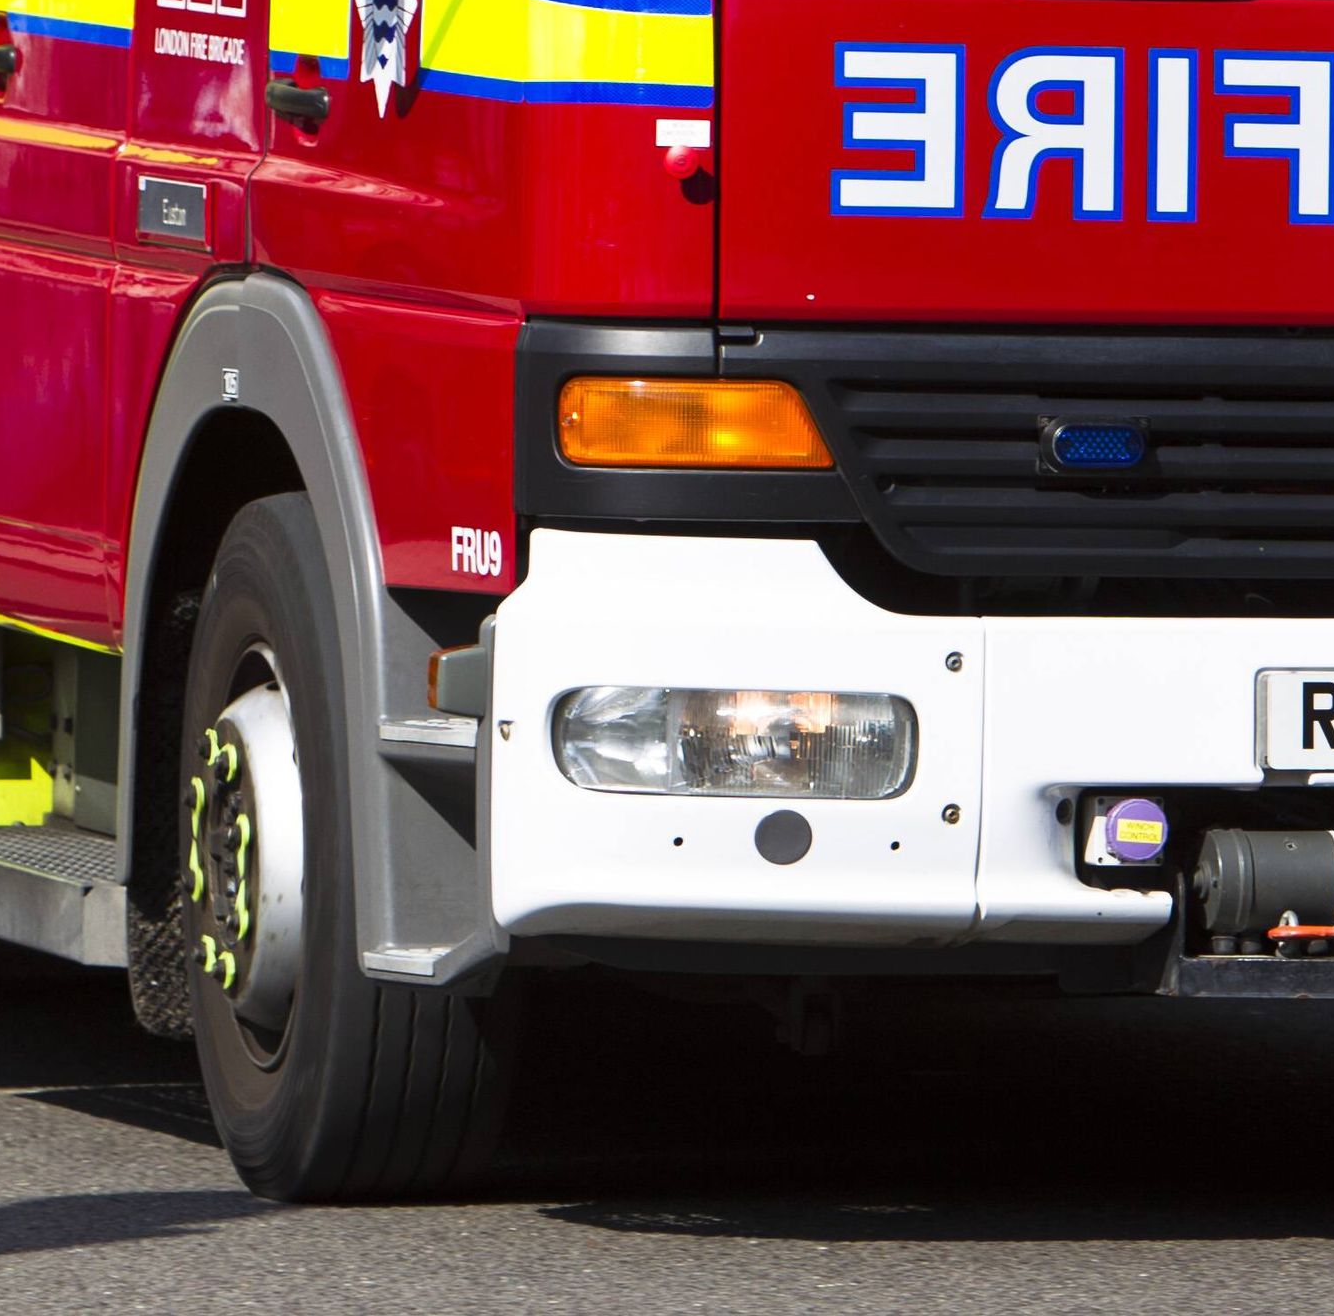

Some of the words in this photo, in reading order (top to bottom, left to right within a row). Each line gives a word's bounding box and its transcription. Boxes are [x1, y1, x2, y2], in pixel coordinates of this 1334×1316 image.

[154, 27, 190, 57] LONDON
[190, 32, 208, 61] FIRE
[208, 35, 245, 65] BRIGADE
[451, 525, 502, 577] FRU9
